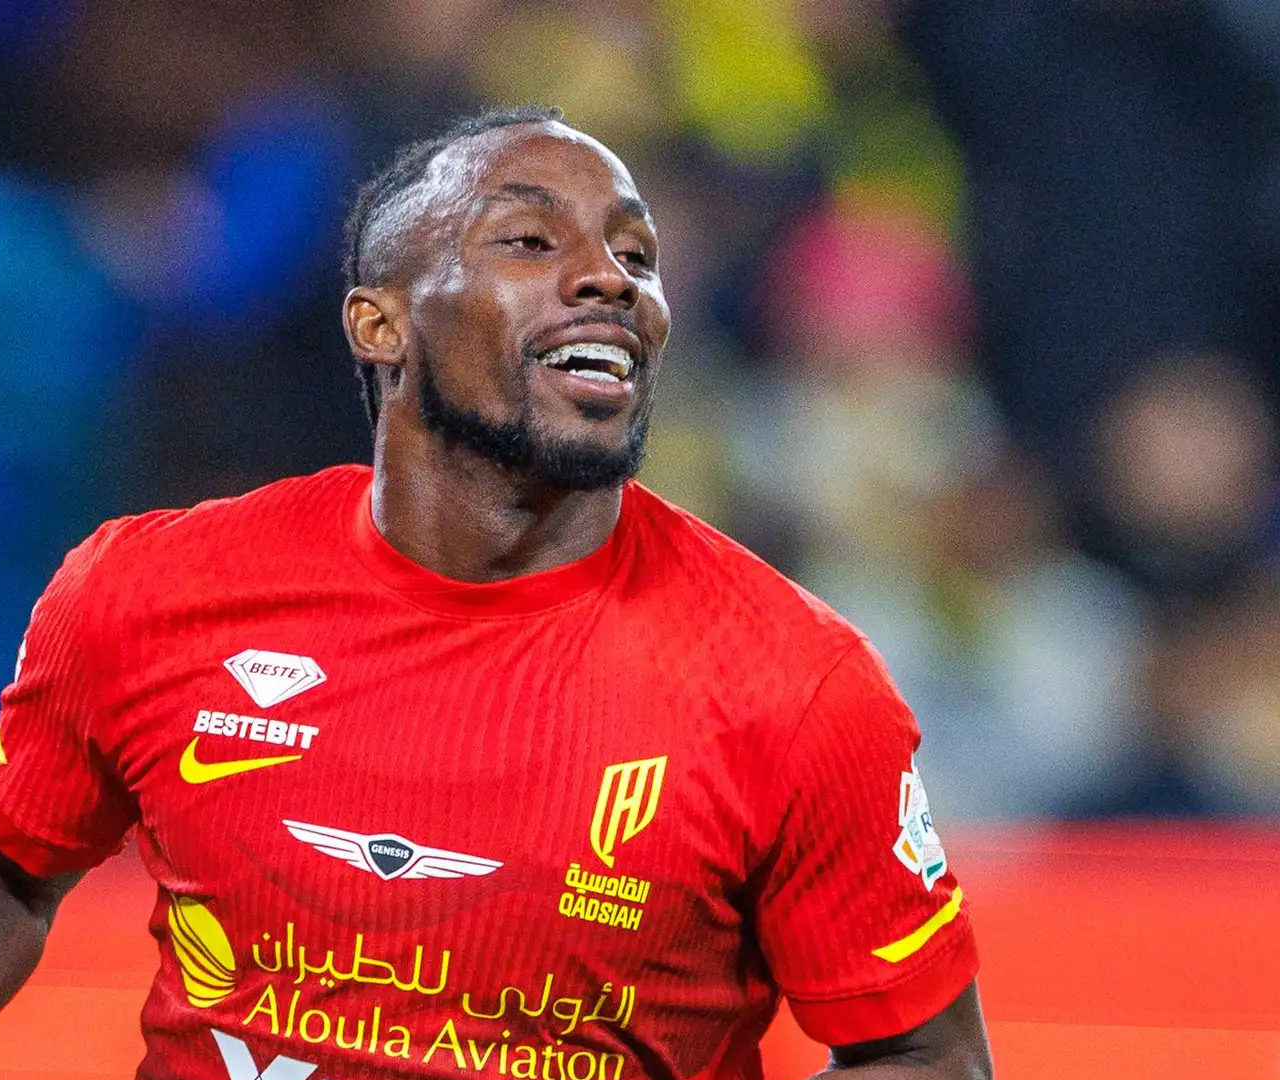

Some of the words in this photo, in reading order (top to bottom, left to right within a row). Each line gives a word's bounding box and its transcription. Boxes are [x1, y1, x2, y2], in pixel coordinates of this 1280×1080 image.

[249, 662, 300, 680] BESTE
[193, 709, 320, 750] BESTEBIT
[370, 843, 410, 859] GENESIS
[565, 862, 651, 904] القادسية
[558, 891, 643, 931] QADSIAH
[251, 921, 451, 996] للطيران
[242, 983, 411, 1060] Aloula
